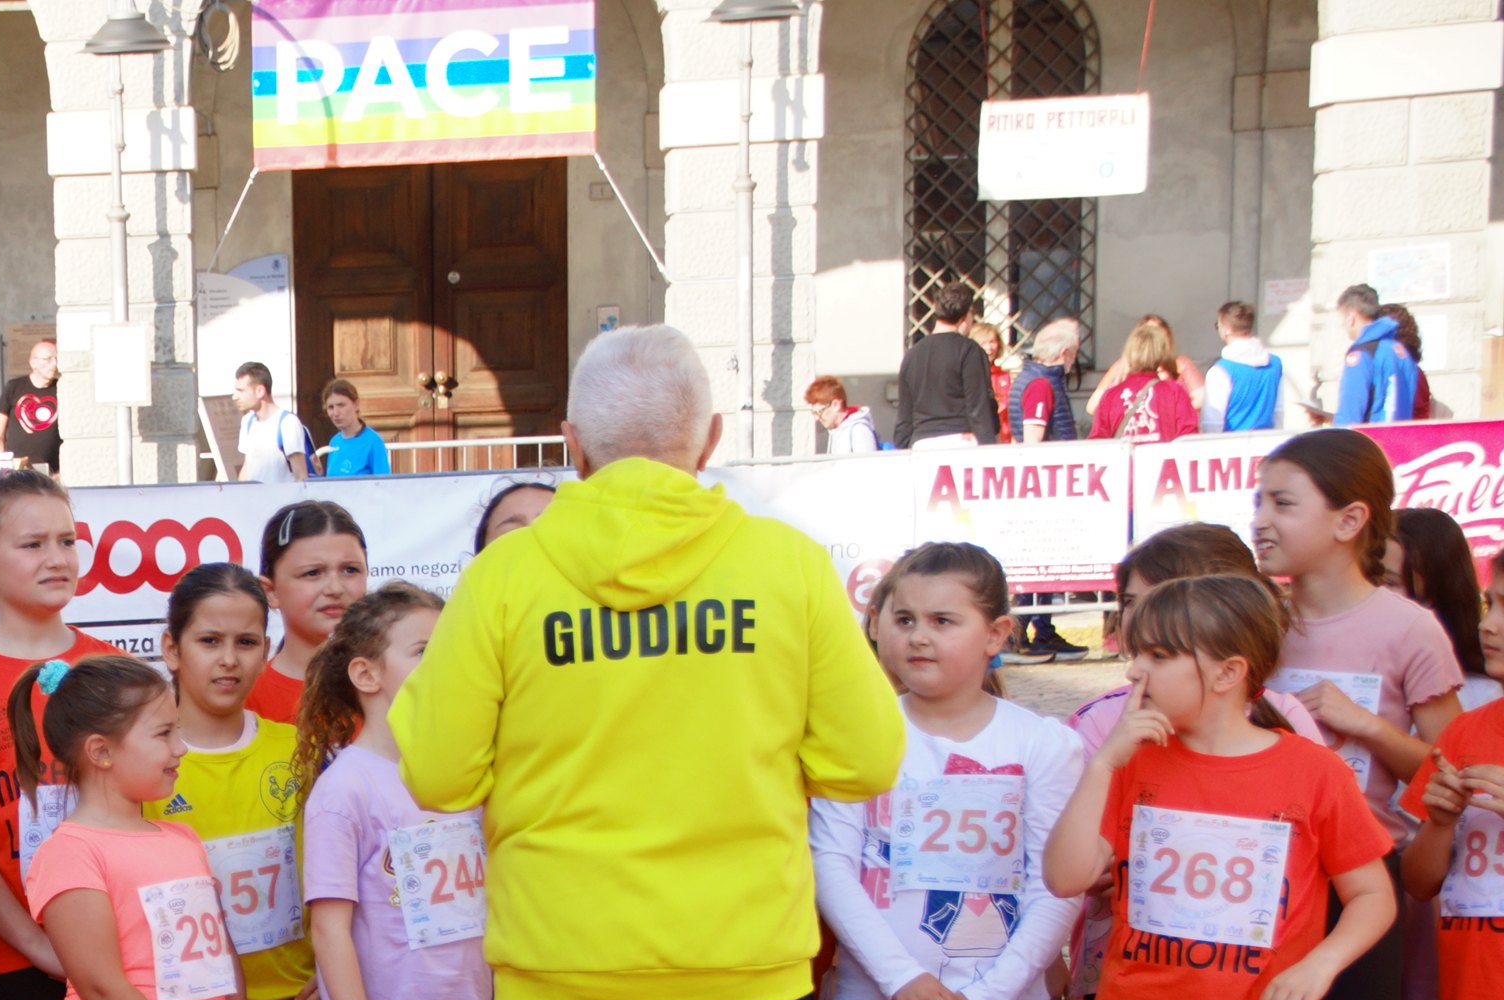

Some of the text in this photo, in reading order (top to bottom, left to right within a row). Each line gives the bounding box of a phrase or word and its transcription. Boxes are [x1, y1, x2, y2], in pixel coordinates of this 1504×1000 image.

[276, 25, 571, 125] PACE
[986, 108, 1136, 132] RITIRO PETTORALI
[926, 463, 1111, 513] ALMATEK
[411, 560, 462, 578] negozi
[542, 598, 756, 668] GIUDICE
[163, 803, 193, 816] adidas
[918, 809, 1018, 857] 253
[1148, 846, 1256, 905] 268
